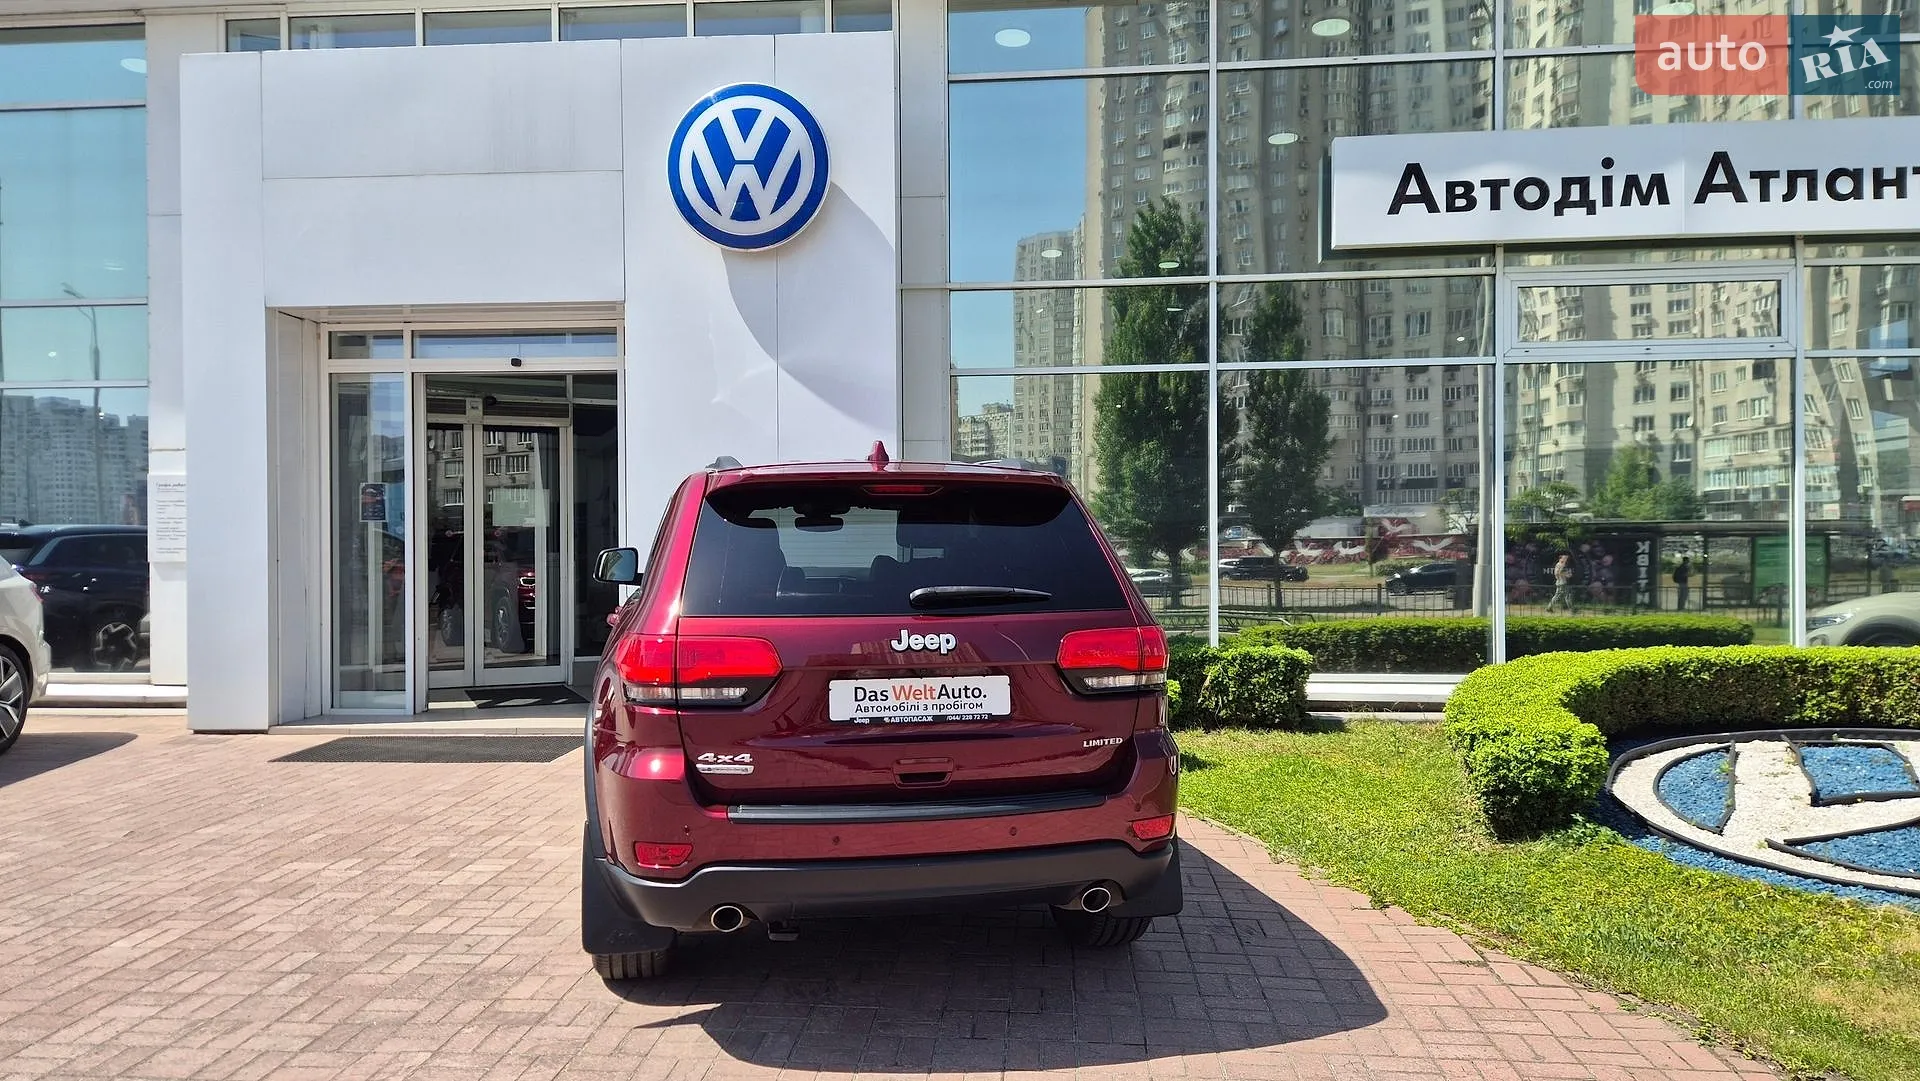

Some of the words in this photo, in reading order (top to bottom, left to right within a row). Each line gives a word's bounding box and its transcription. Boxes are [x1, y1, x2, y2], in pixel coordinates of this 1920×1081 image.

[1387, 156, 1671, 216] Автодім
[890, 629, 957, 655] Jeep
[854, 686, 889, 702] Das
[855, 702, 920, 714] Автомобілі
[922, 703, 929, 712] з
[931, 700, 984, 713] пробігом
[890, 715, 934, 723] АВТОПАСАЖ
[1083, 737, 1123, 748] LIMITED
[697, 752, 753, 763] 4x4
